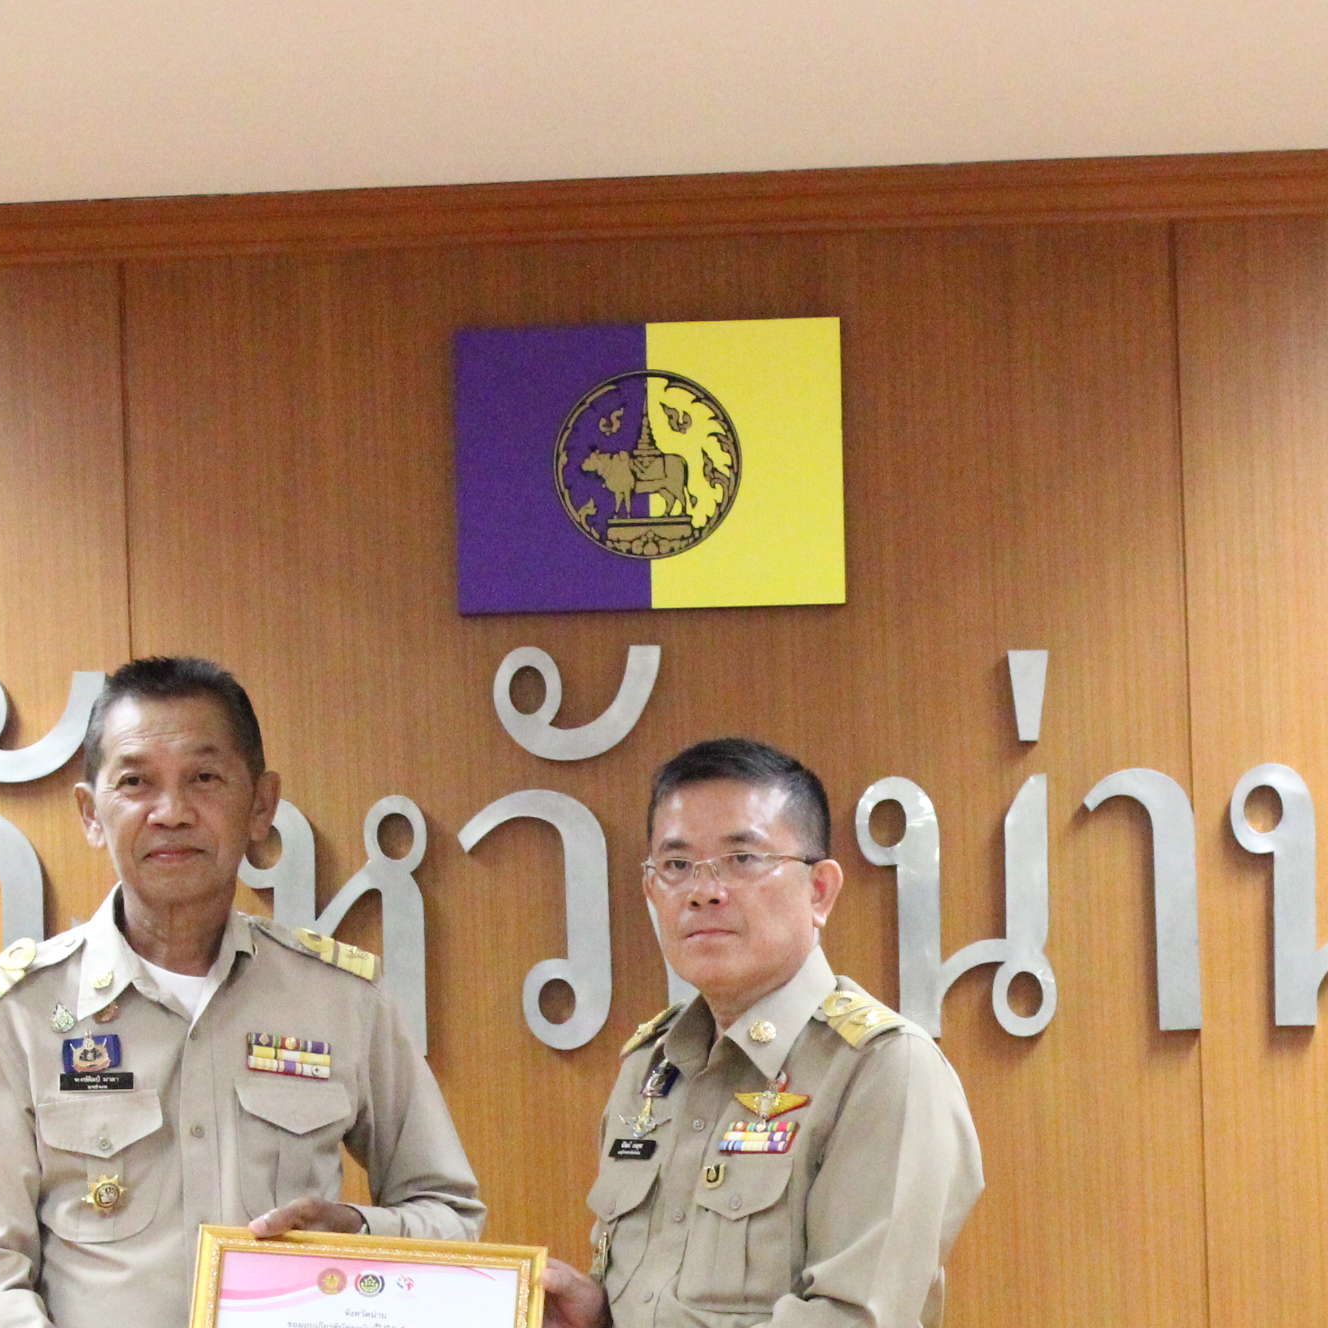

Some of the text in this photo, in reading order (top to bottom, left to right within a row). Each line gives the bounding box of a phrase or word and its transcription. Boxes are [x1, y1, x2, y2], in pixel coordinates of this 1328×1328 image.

[344, 1308, 387, 1319] จังหวัดน่าน
